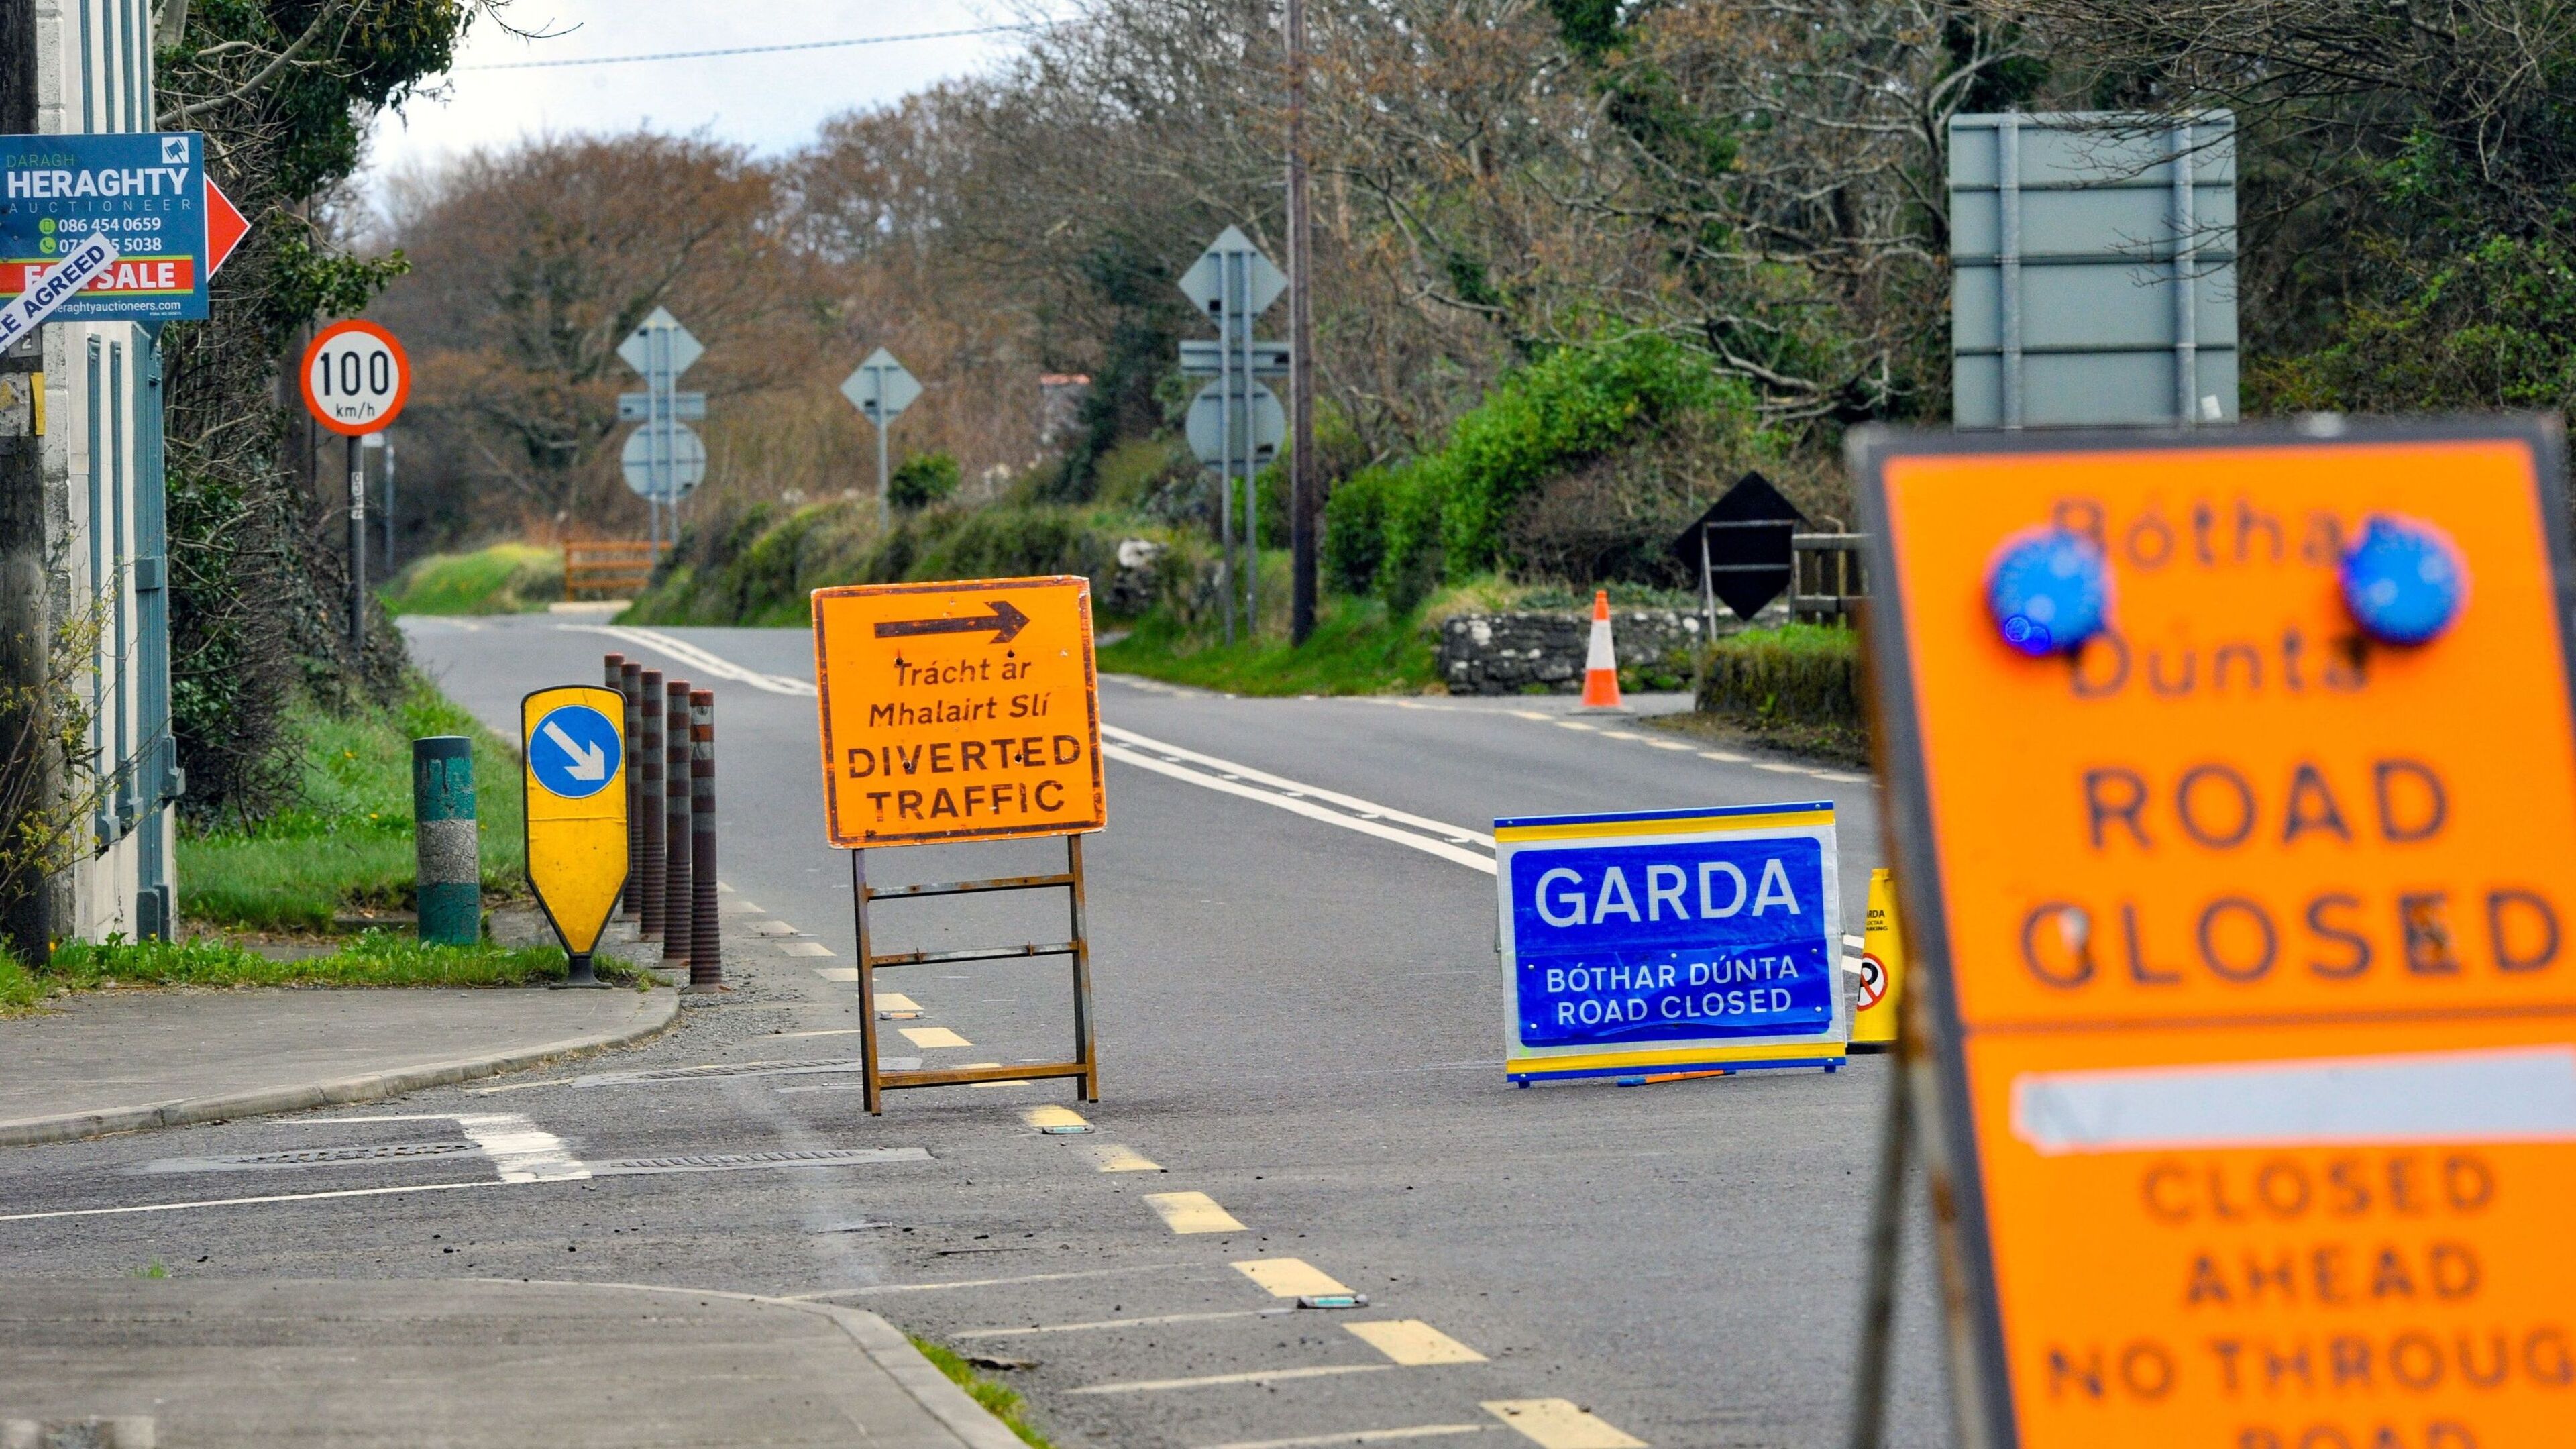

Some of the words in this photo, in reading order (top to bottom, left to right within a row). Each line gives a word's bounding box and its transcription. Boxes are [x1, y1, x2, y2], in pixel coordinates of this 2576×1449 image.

[7, 154, 75, 168] DARAGH
[7, 168, 189, 198] HERAGHTY
[9, 199, 191, 213] AUCTIONEER
[58, 219, 87, 232] 086
[91, 218, 119, 232] 454
[123, 217, 162, 231] 0659
[59, 239, 85, 253] 07
[124, 237, 162, 251] 5038
[23, 245, 105, 319] AGREED
[97, 262, 176, 290] SALE
[320, 350, 389, 396] 100
[336, 402, 375, 419] km/h
[894, 657, 989, 687] Trácht
[1002, 661, 1032, 680] ar
[869, 697, 998, 728] Mhalairt
[1009, 692, 1051, 718] Slí
[847, 735, 1081, 779] DIVERTED
[867, 780, 1065, 822] TRAFFIC
[2082, 759, 2447, 849] ROAD
[1535, 858, 1801, 928] GARDA
[1867, 910, 1885, 918] RDA
[2021, 890, 2561, 989] CLOSED
[1547, 961, 1676, 993] BÓTHAR
[1690, 953, 1799, 986] DÚNTA
[1558, 998, 1648, 1025] ROAD
[1660, 988, 1792, 1019] CLOSED
[2142, 1154, 2496, 1222] CLOSED
[2187, 1244, 2481, 1307] AHEAD
[2047, 1342, 2176, 1400] NO
[2210, 1326, 2576, 1392] THROUG
